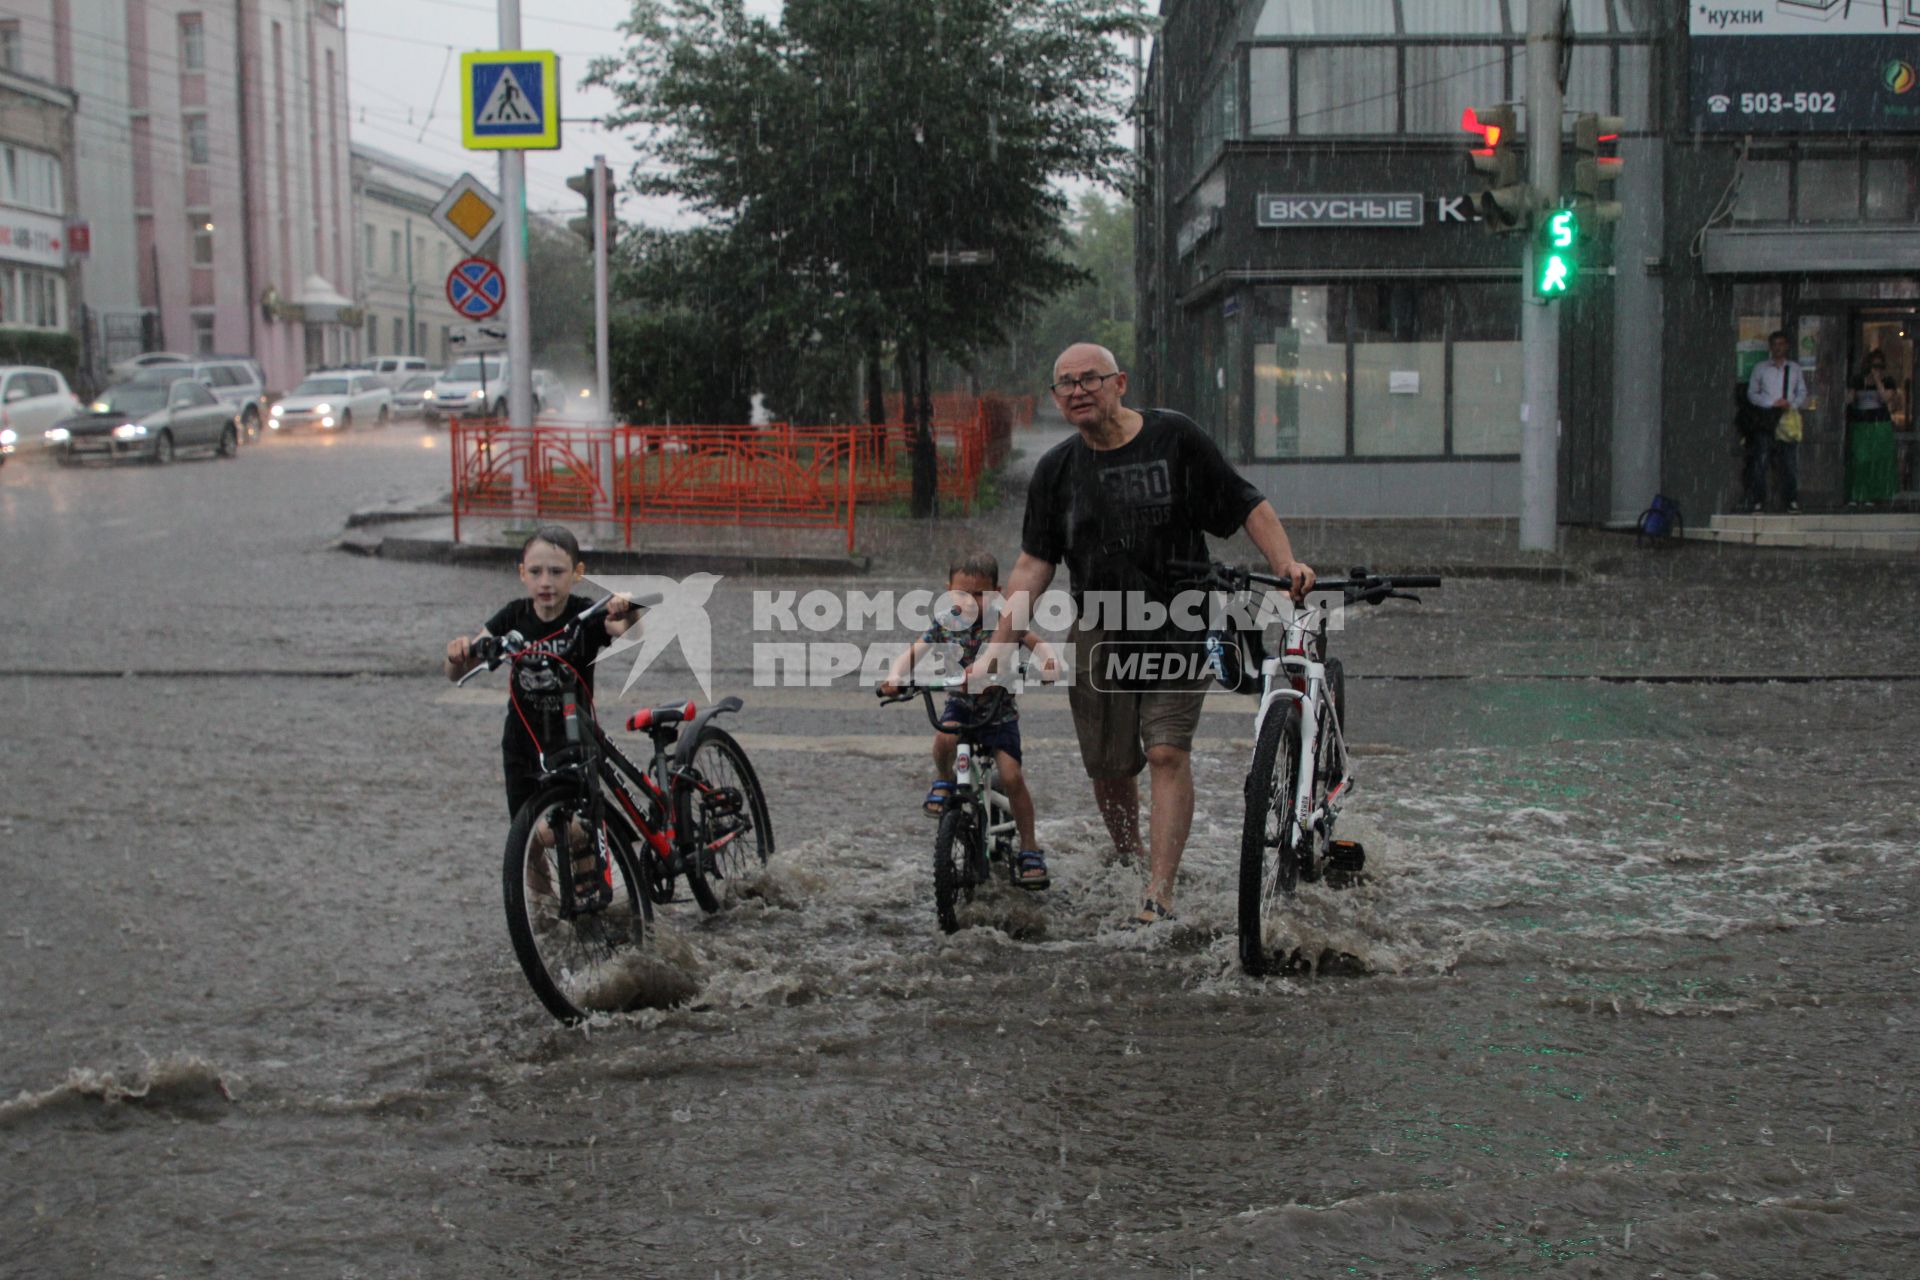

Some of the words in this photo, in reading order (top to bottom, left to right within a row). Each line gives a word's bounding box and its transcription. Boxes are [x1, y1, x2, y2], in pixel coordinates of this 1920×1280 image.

[1740, 92, 1836, 114] 503-502
[1268, 199, 1413, 219] ВКУСНЫЕ
[1552, 211, 1573, 247] 5
